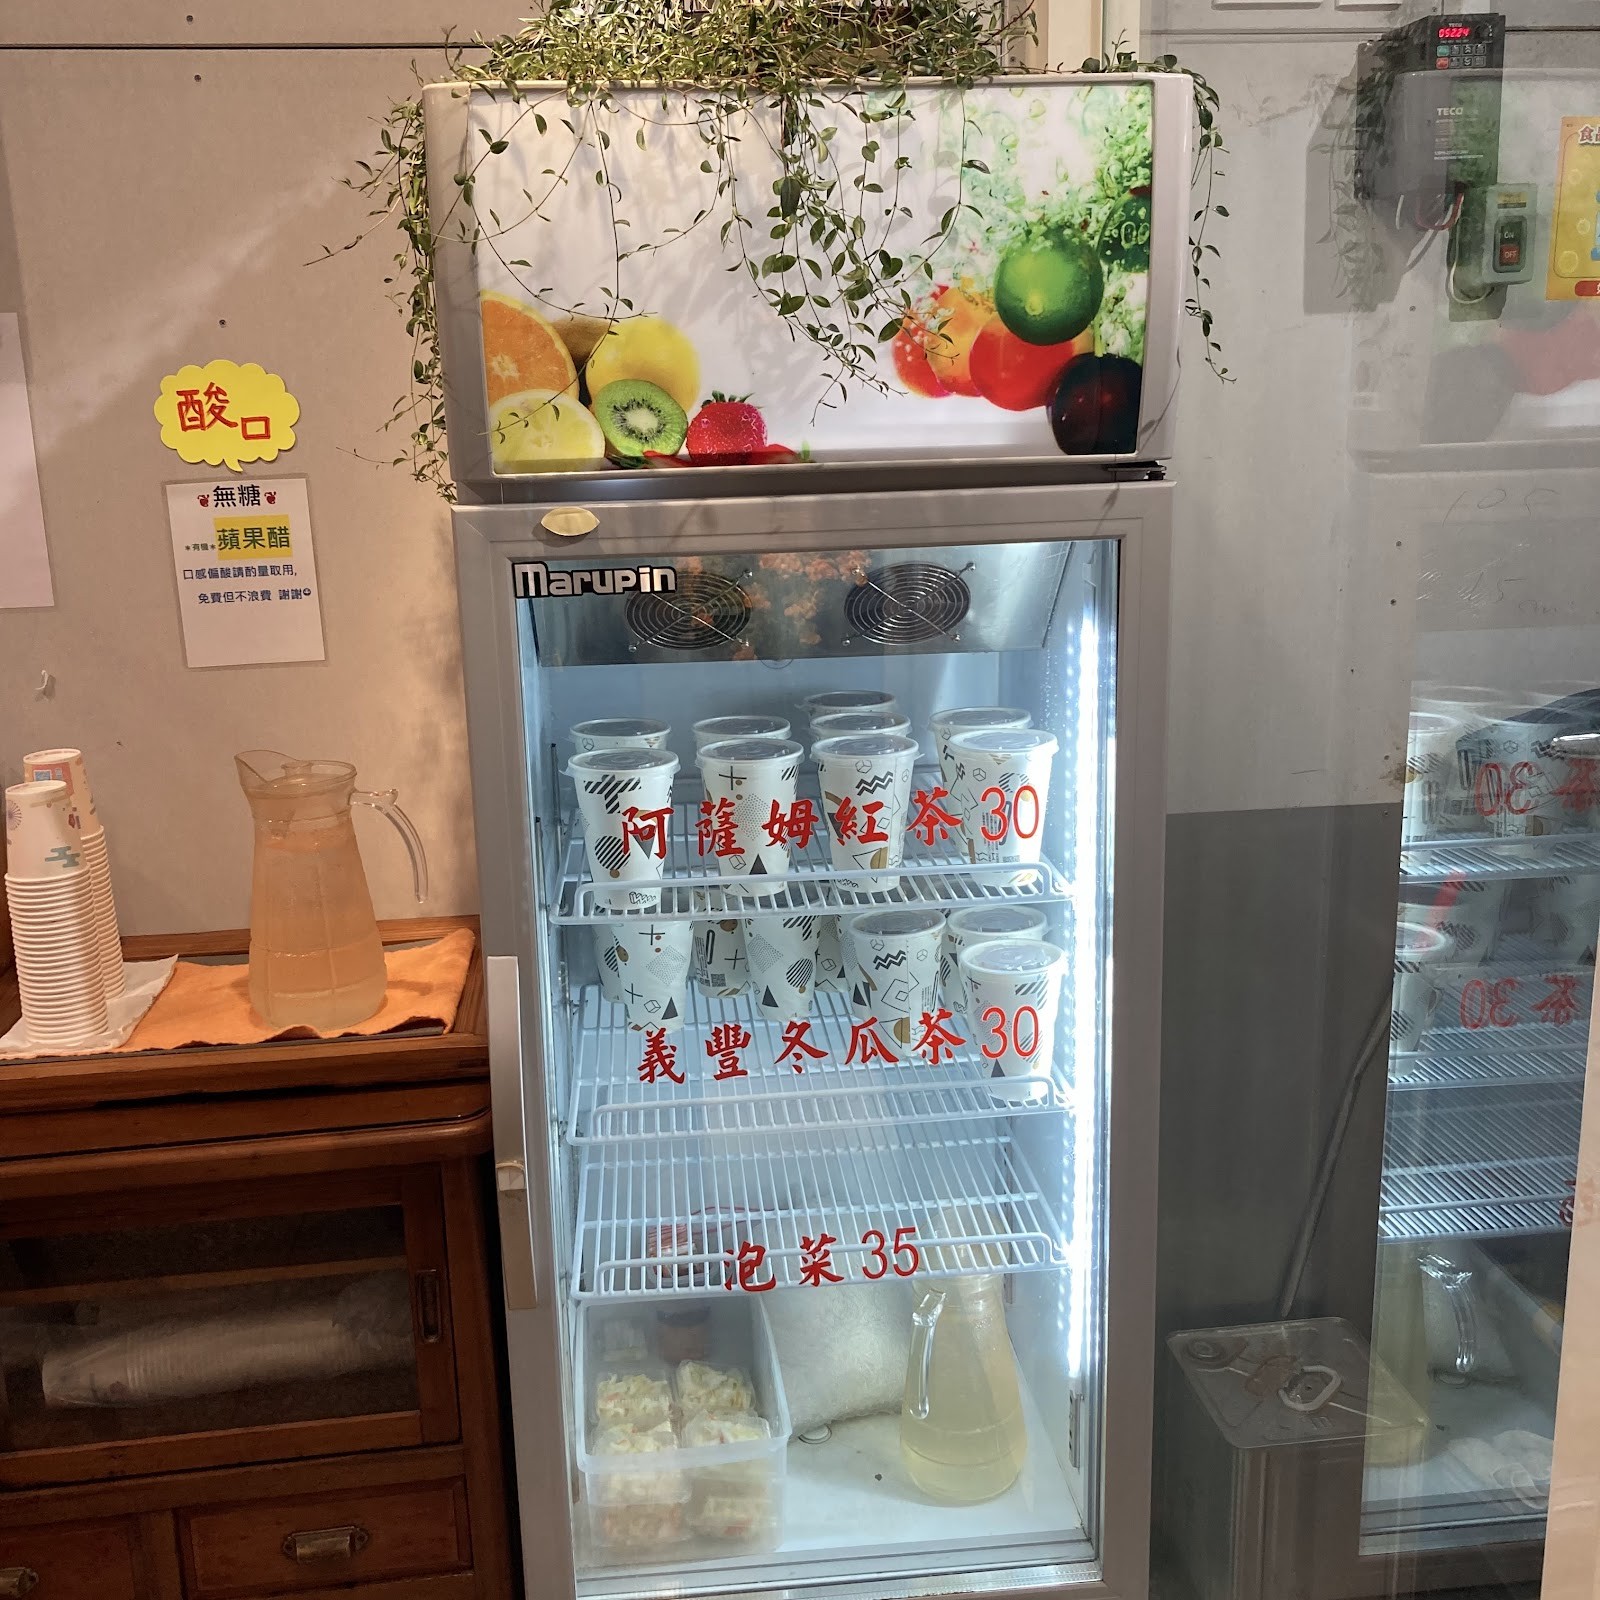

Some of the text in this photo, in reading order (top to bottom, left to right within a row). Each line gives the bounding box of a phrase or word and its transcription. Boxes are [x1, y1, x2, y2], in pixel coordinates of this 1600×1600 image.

[1436, 107, 1463, 116] TECO
[1504, 250, 1517, 259] OFF
[176, 382, 271, 440] 酸口
[212, 484, 261, 508] 無糖
[278, 588, 303, 601] 謝謝
[513, 562, 677, 598] Marupin
[621, 786, 963, 859] 阿薩姆紅茶
[980, 785, 1040, 842] 30
[636, 1005, 1040, 1085] 義豐冬瓜茶 30
[723, 1226, 920, 1292] 泡菜 35
